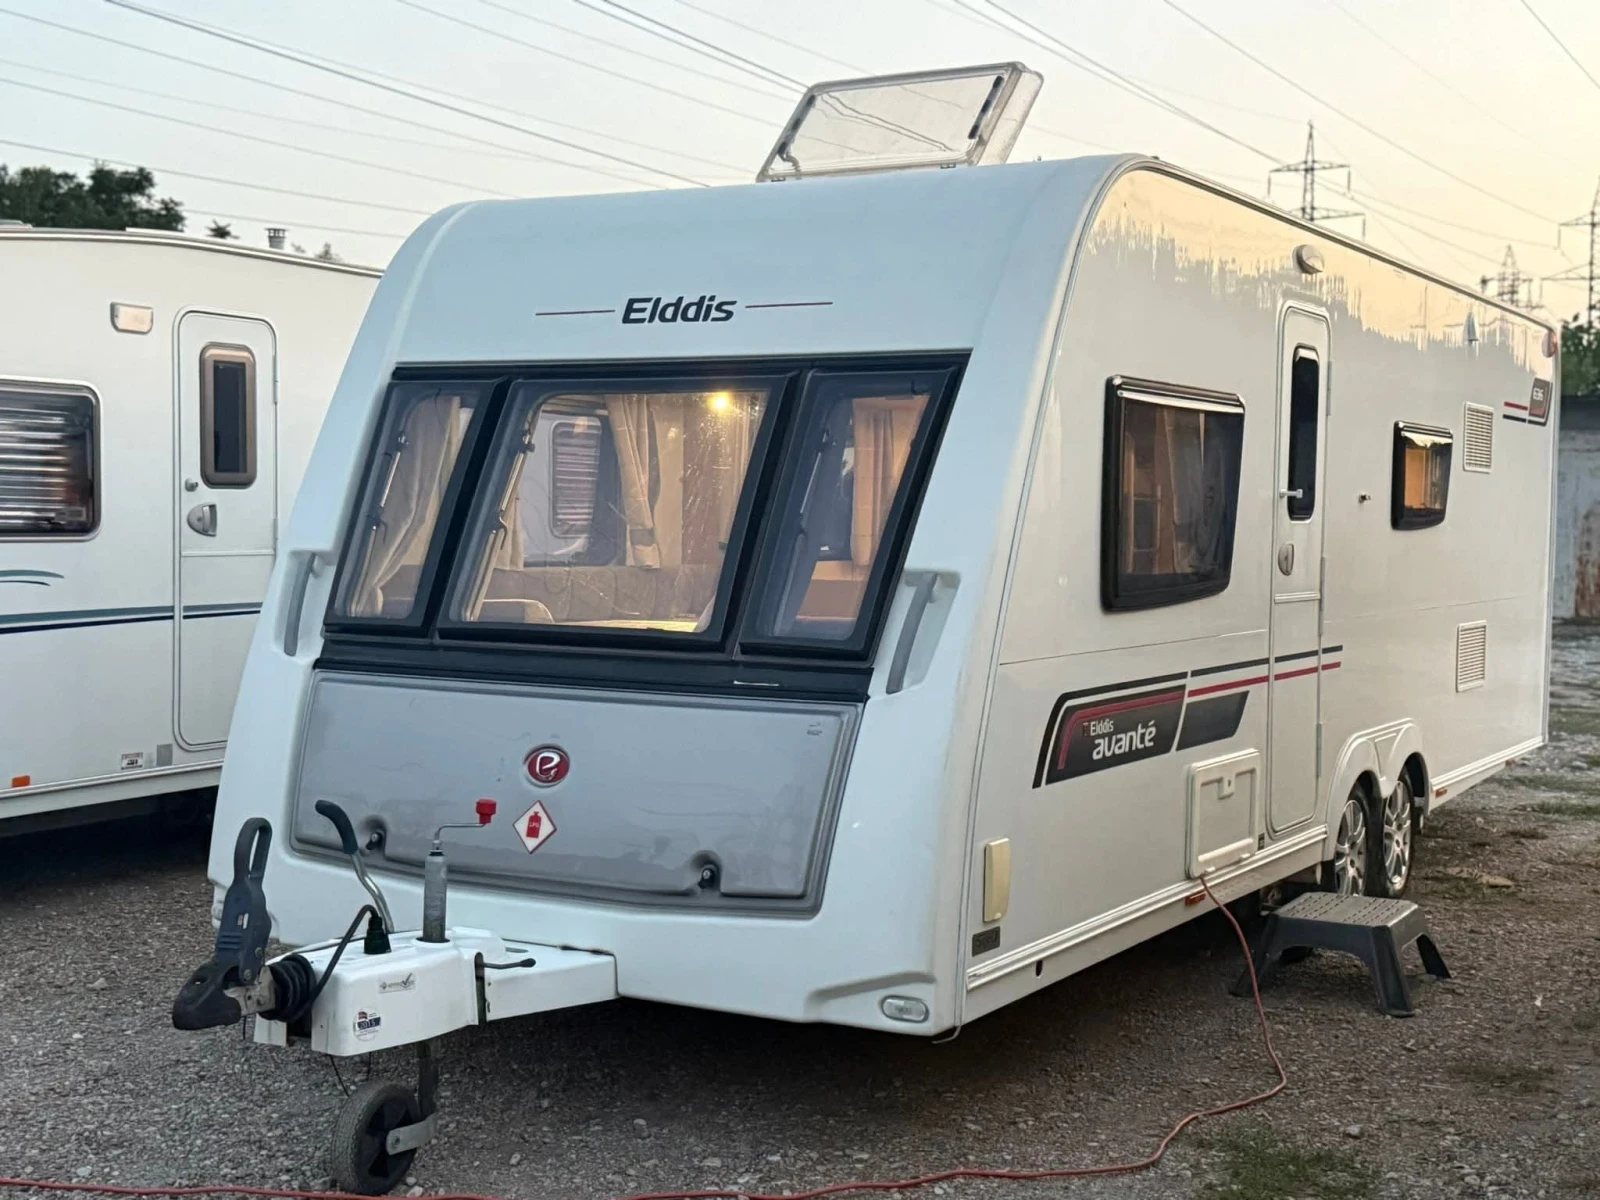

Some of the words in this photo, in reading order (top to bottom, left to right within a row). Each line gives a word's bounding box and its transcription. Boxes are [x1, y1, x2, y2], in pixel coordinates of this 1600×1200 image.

[622, 295, 738, 324] Elddis
[1090, 719, 1114, 736] Elddis
[1092, 720, 1156, 760] avanté
